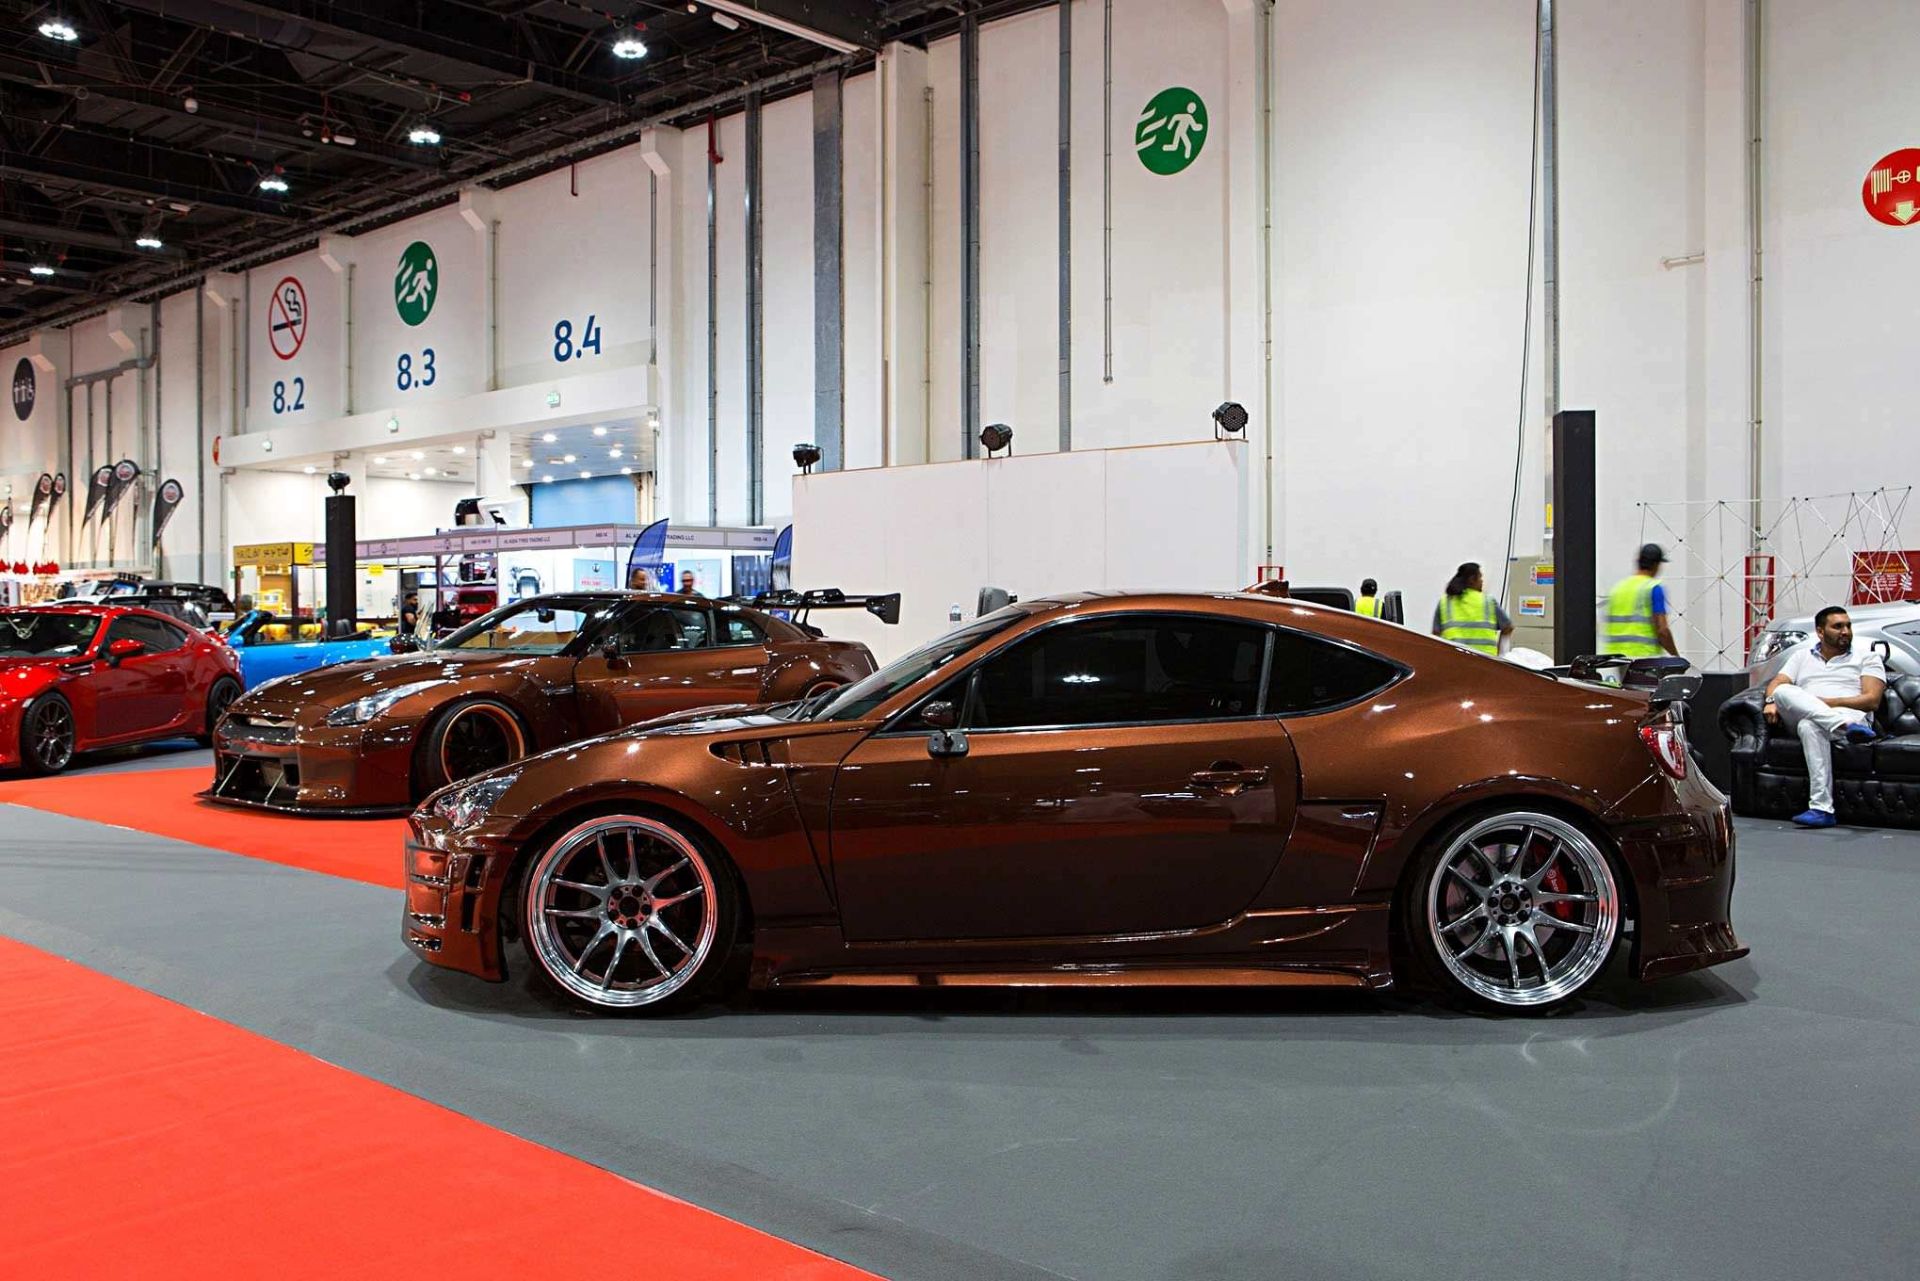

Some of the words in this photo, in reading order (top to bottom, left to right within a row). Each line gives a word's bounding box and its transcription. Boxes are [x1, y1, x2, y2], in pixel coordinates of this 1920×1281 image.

[554, 315, 601, 362] 8.4
[397, 348, 436, 391] 8.3
[273, 377, 305, 414] 8.2
